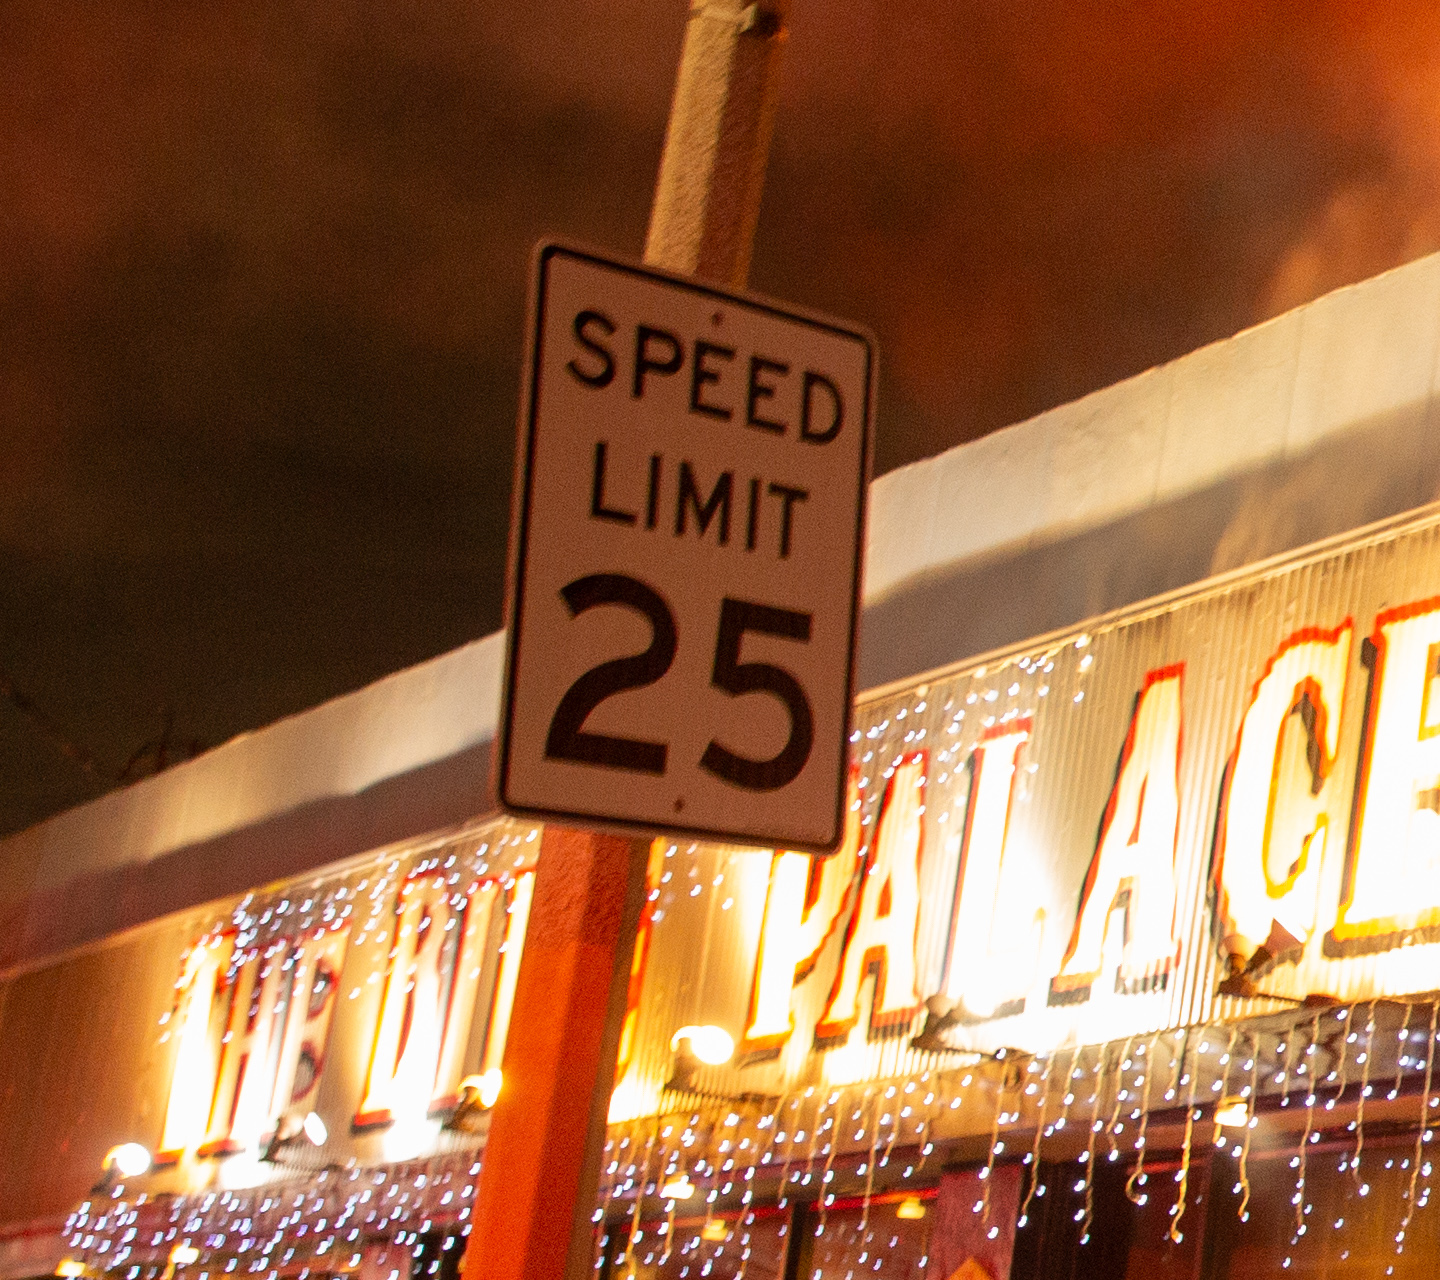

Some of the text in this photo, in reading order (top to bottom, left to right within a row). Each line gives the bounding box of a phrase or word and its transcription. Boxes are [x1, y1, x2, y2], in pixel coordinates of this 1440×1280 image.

[565, 309, 846, 447] SPEED
[590, 441, 808, 559] LIMIT
[543, 572, 816, 792] 25
